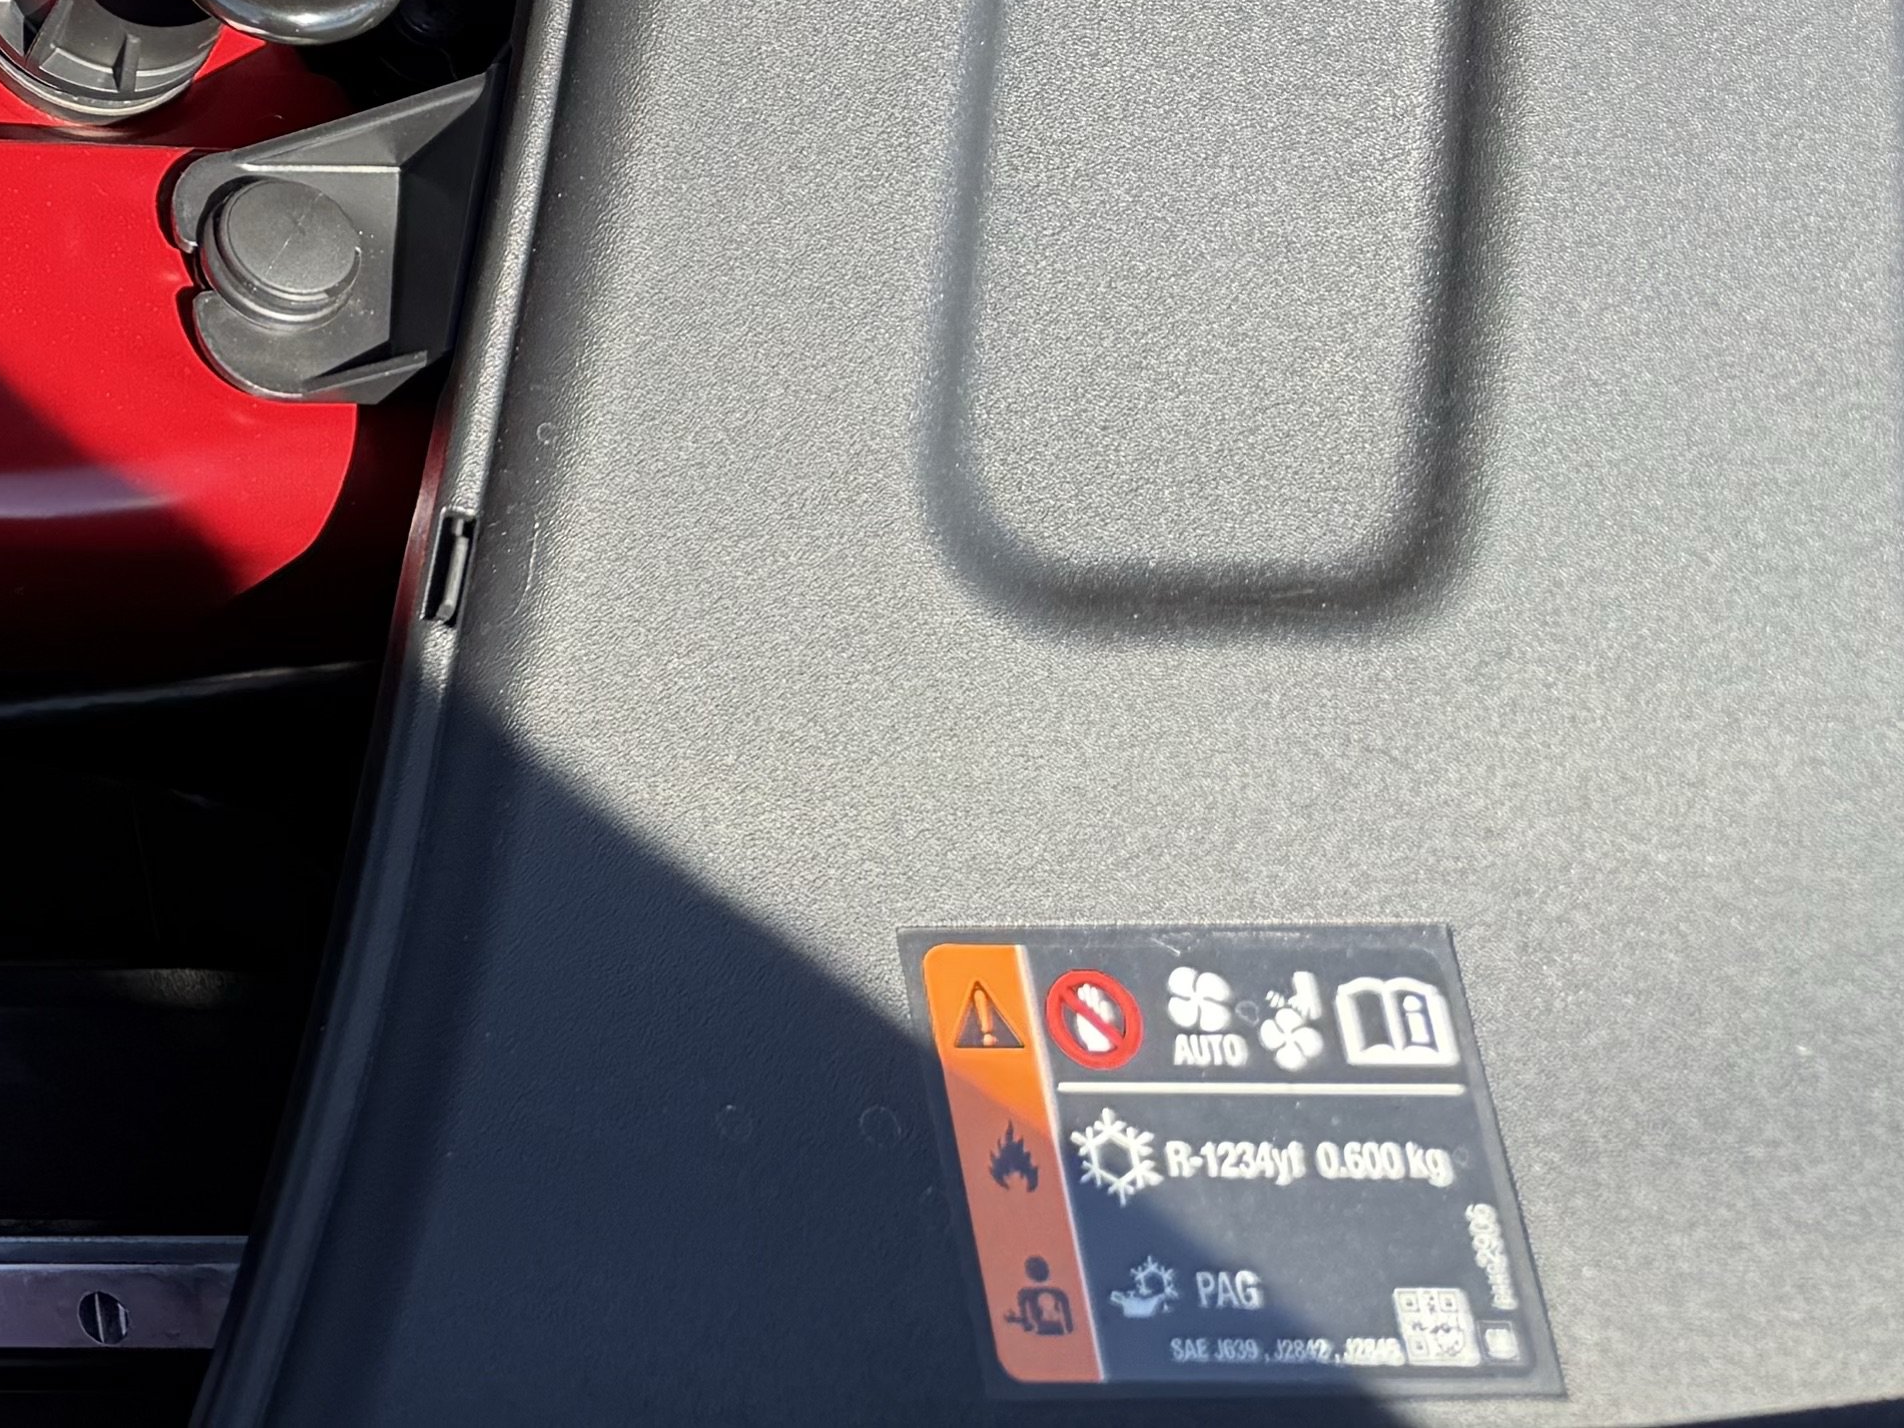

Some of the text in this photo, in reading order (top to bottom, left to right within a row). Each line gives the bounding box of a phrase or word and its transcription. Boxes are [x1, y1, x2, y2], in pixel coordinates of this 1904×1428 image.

[1173, 1033, 1247, 1067] AUTO
[1316, 1142, 1395, 1181] 0.600
[1405, 1144, 1455, 1187] kg
[1196, 1270, 1264, 1311] PAG
[1170, 1337, 1210, 1362] SAE
